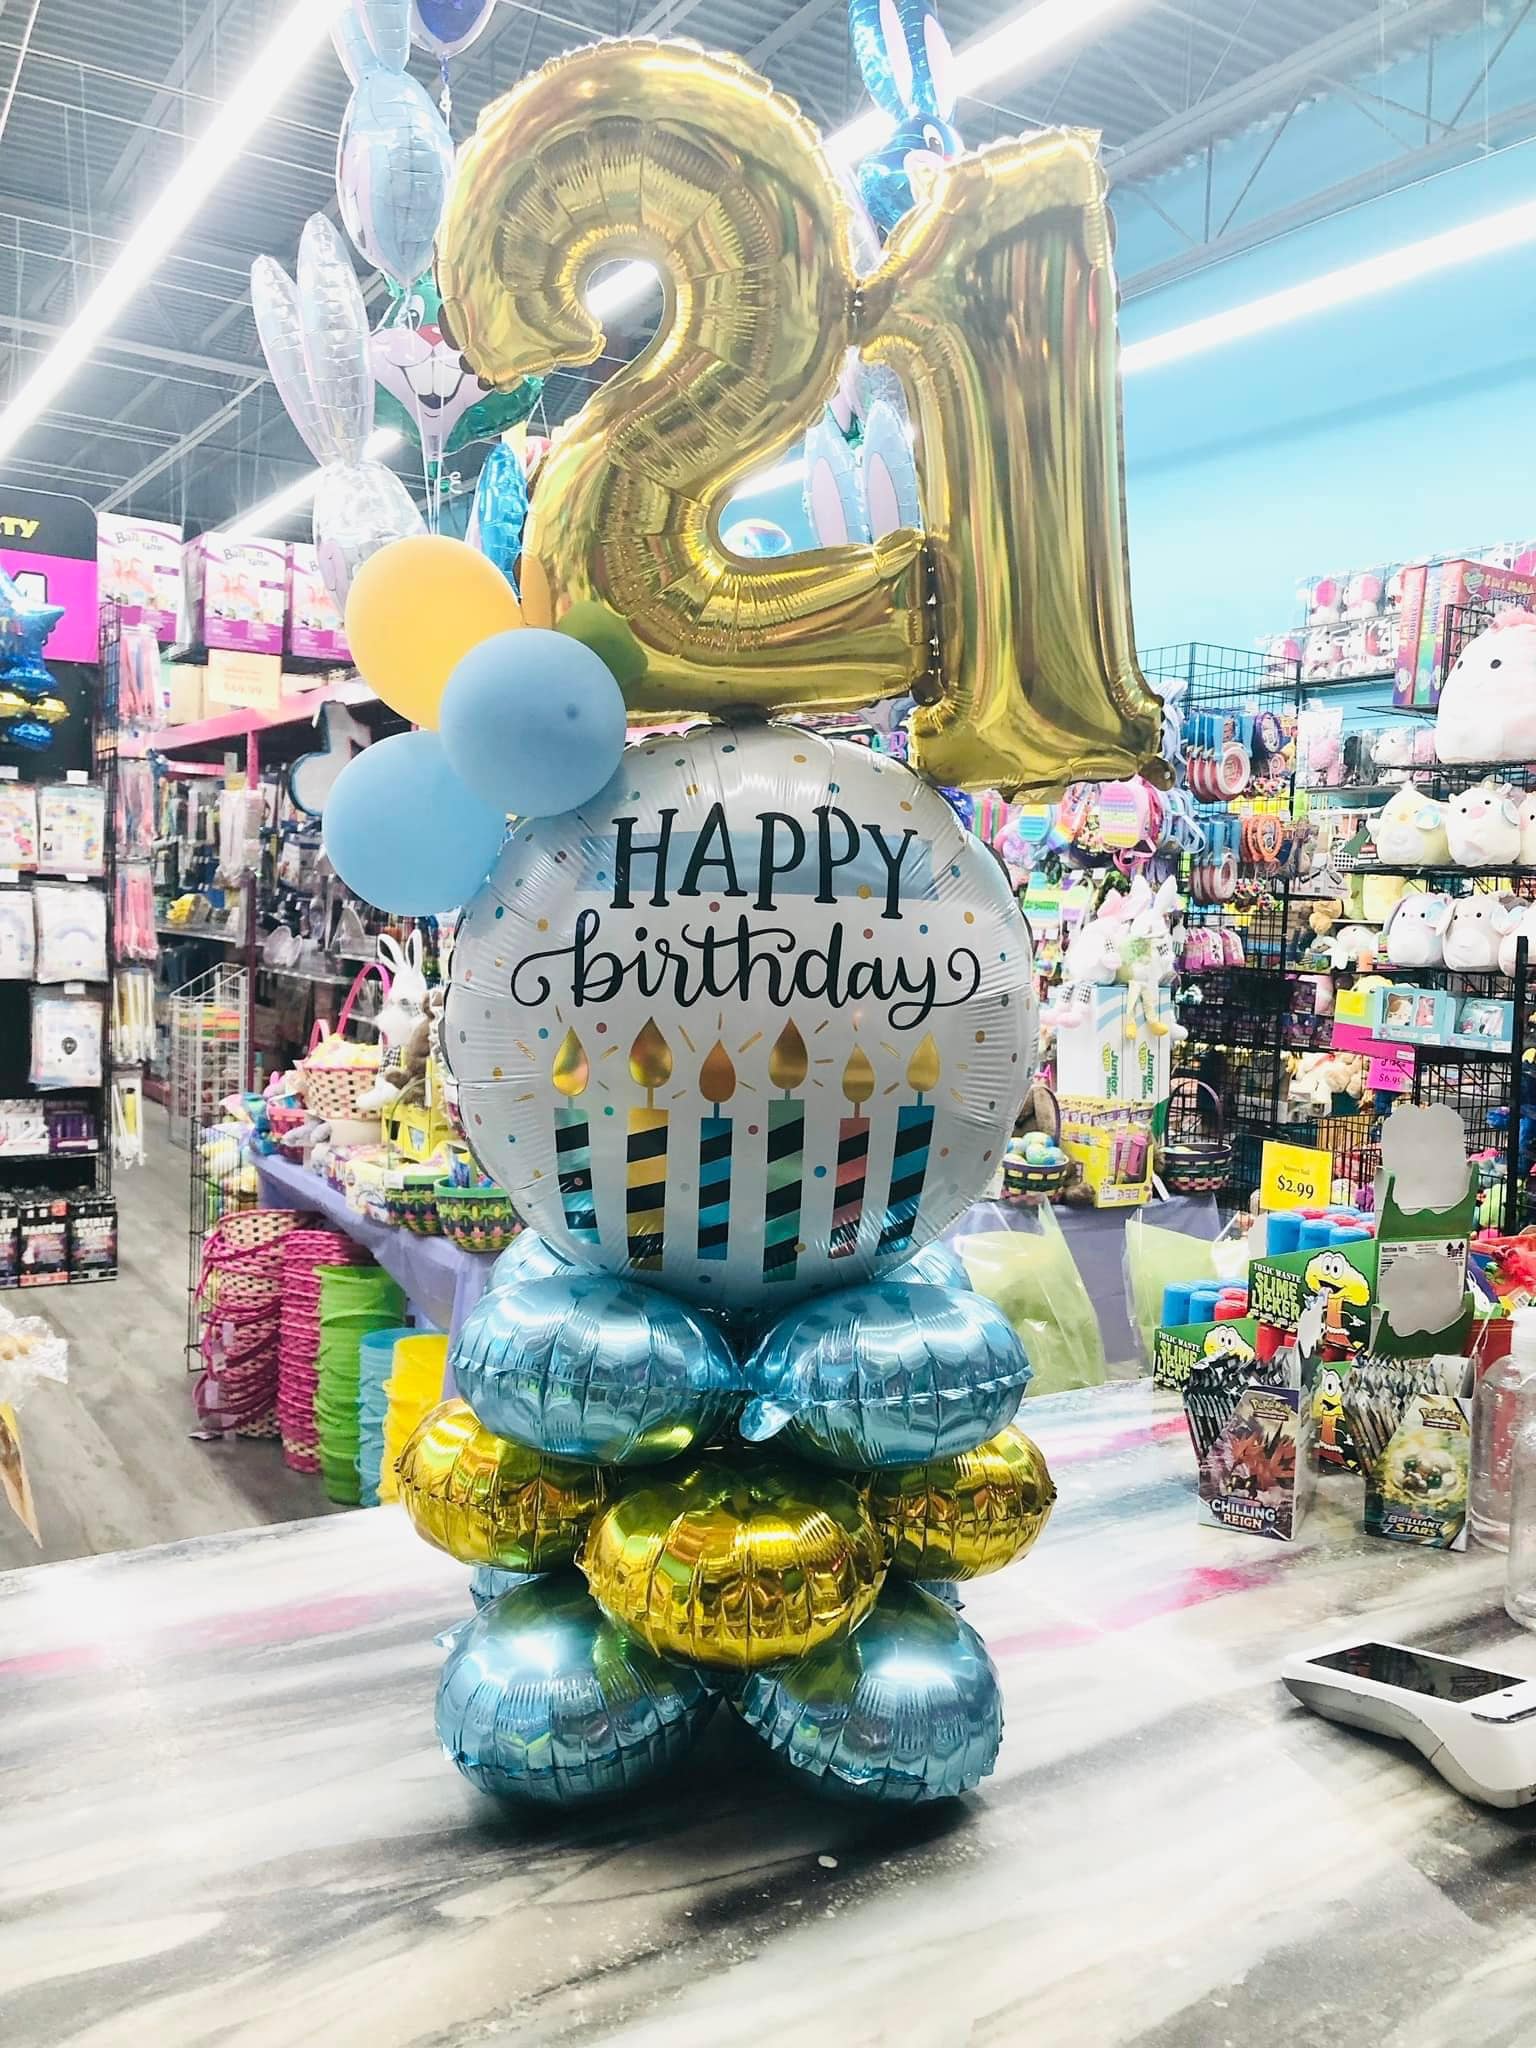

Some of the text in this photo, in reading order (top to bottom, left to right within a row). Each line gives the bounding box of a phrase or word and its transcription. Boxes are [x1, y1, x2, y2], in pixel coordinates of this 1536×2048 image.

[609, 802, 919, 920] HAPPY
[510, 909, 981, 1031] birthday
[1111, 1050, 1119, 1096] Junior
[1147, 1049, 1155, 1094] Junior
[1277, 1174, 1314, 1200] $2.99
[1253, 1262, 1302, 1284] TOXIC WASTE
[1255, 1272, 1298, 1300] SLIME
[1251, 1290, 1301, 1321] LICKER
[1158, 1330, 1201, 1353] TOXIC WASTE
[1160, 1340, 1198, 1367] SLIME
[1157, 1356, 1191, 1381] LICKE
[1211, 1498, 1276, 1522] CHILLING
[1223, 1513, 1262, 1530] REIGN
[1387, 1514, 1441, 1530] BRILLIANT
[1395, 1522, 1437, 1537] STARS
